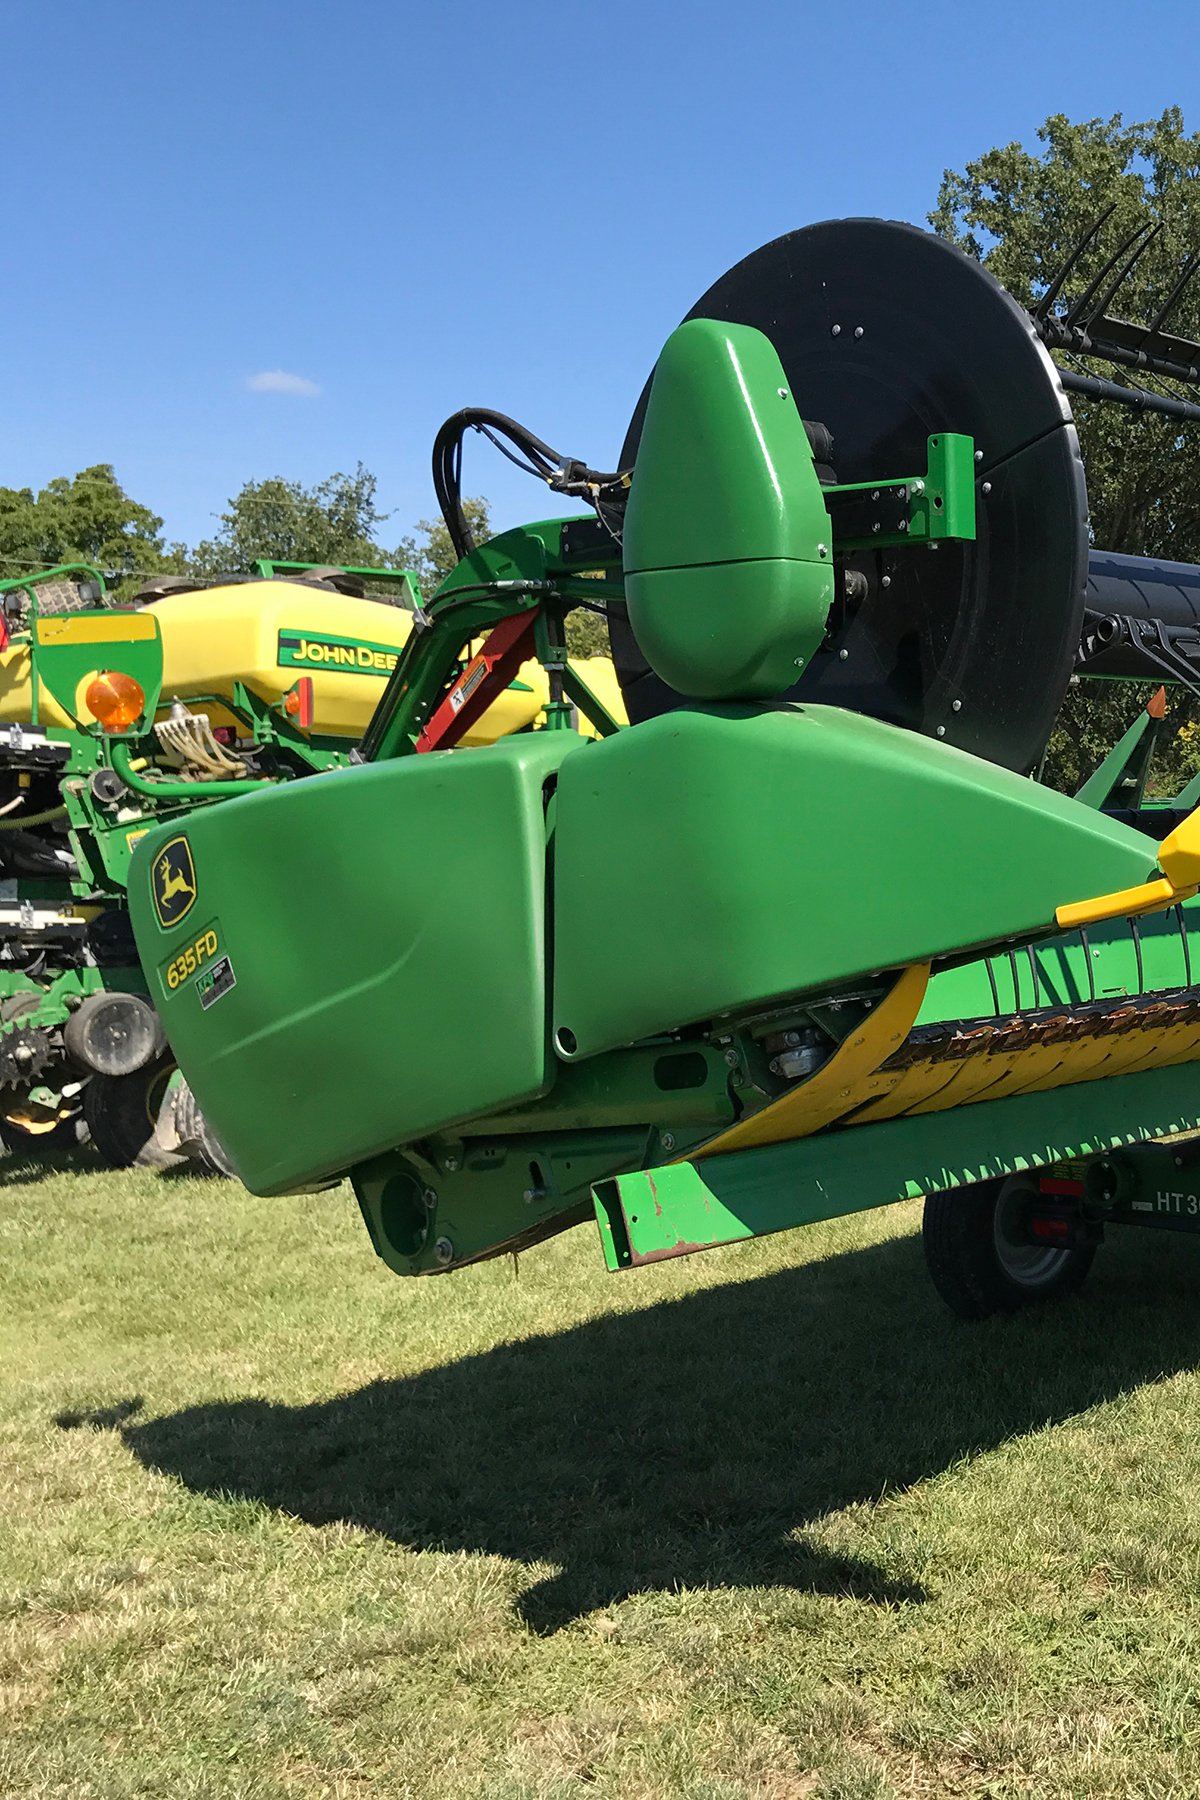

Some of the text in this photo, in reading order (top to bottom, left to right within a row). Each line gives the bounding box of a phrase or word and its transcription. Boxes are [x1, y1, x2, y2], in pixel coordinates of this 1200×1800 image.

[293, 639, 398, 670] JOHN DEE
[167, 930, 218, 989] 635FD
